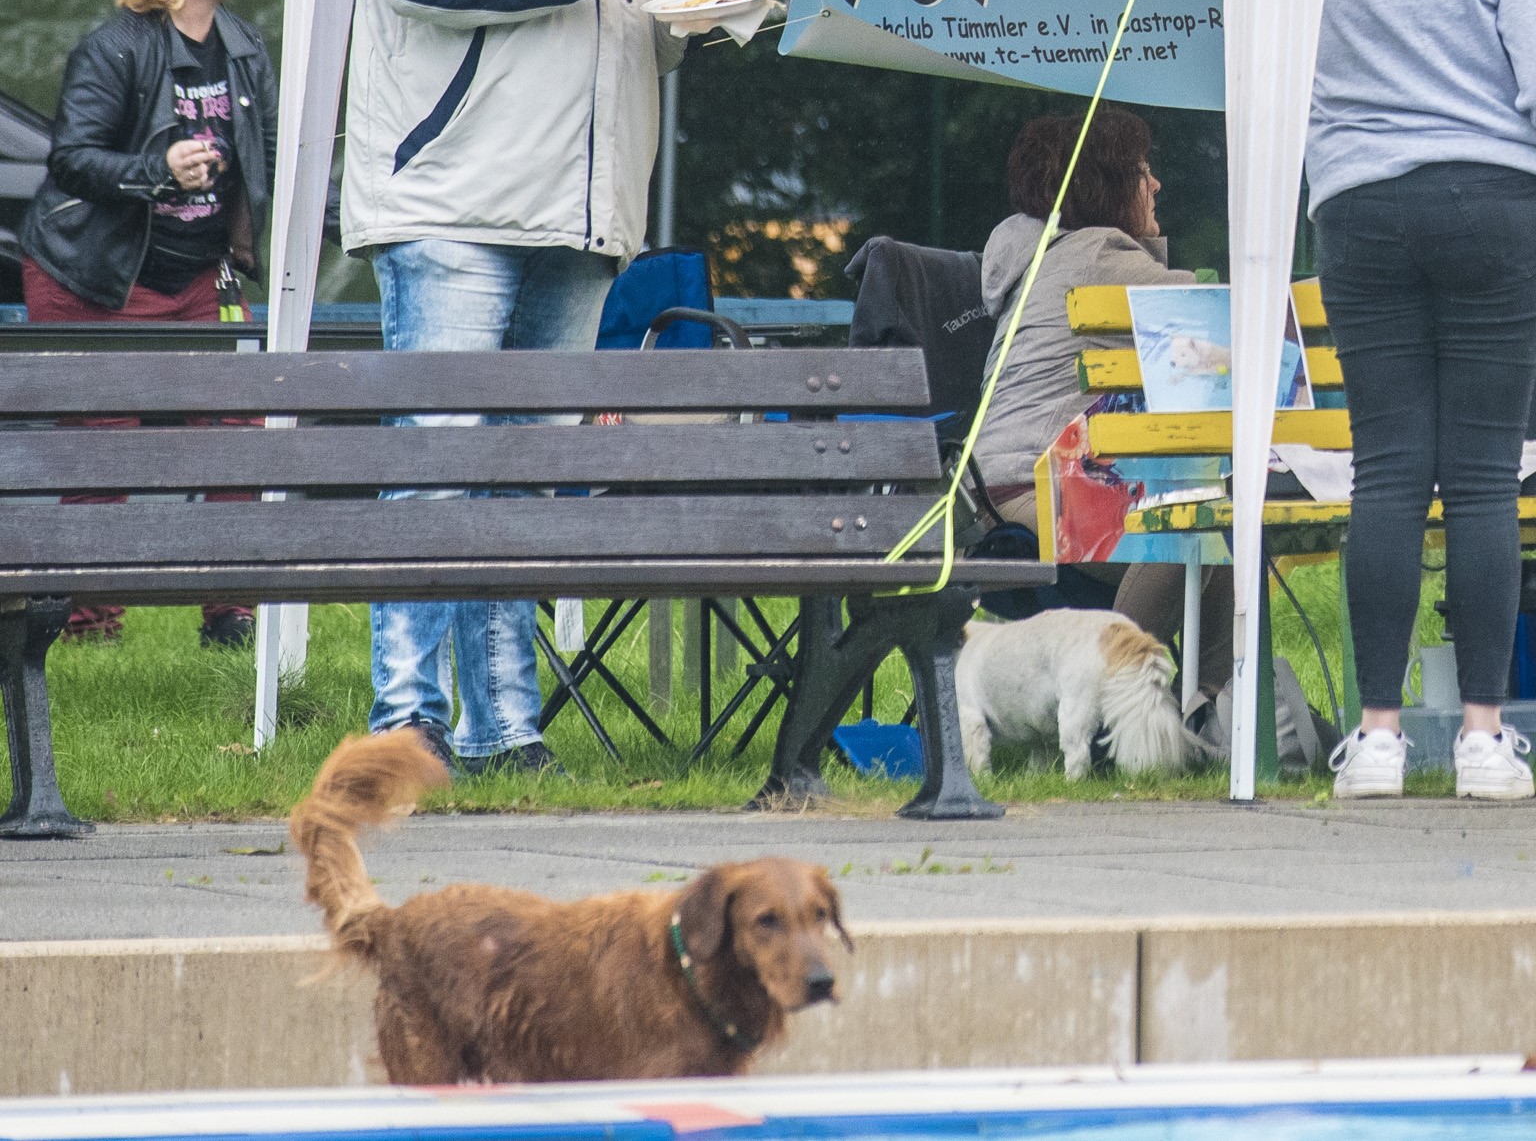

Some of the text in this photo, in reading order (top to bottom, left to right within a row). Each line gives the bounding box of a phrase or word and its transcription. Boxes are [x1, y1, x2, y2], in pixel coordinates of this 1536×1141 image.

[941, 14, 1028, 39] Tümmler
[1037, 14, 1081, 37] e.V.
[1089, 13, 1108, 34] in
